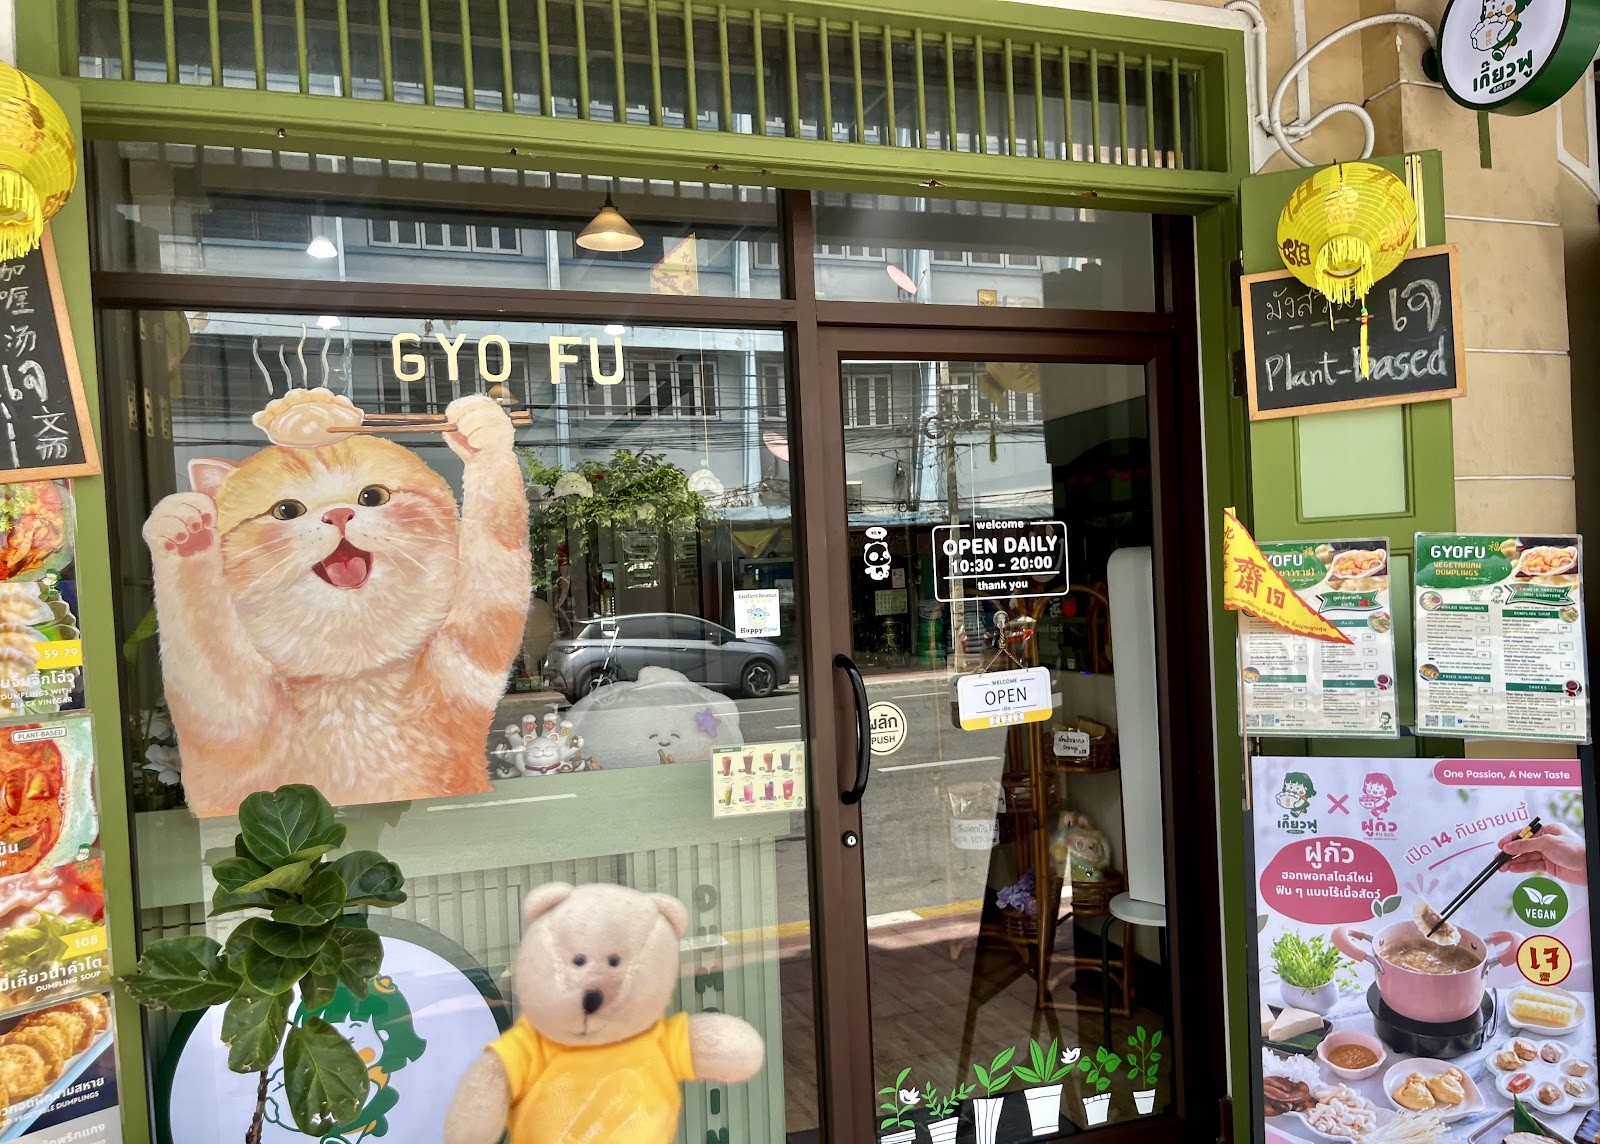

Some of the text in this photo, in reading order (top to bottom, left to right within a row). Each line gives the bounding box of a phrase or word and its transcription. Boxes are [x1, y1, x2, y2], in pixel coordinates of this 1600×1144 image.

[1473, 49, 1533, 92] เกี๊ยวฟู
[1389, 278, 1441, 332] เจ
[391, 333, 626, 384] GYO FU
[976, 519, 1024, 530] welcome
[943, 535, 1058, 556] OPEN DAILY
[1430, 545, 1486, 559] GYOFU
[951, 558, 994, 574] 10:30
[1010, 556, 1053, 571] 20:00
[1433, 561, 1481, 569] VEGETARIAN
[977, 580, 1028, 592] thank you
[44, 647, 79, 660] 59-79
[991, 677, 1018, 686] WELCOME
[1, 687, 72, 700] DUMPLINGS WITH
[985, 686, 1028, 706] OPEN
[11, 695, 74, 709] BLACK VINEGAR
[17, 730, 64, 741] PLANT-BASED
[872, 735, 896, 745] PUSH
[1443, 769, 1571, 781] One Passion, A New Taste
[1277, 814, 1318, 834] เกี๊ยวฟู
[1405, 801, 1530, 865] เปิด 14 กันยายนนี้
[1305, 841, 1355, 869] ฝูกัว
[1281, 871, 1374, 884] ฮอทพอทสไตล์ใหม่
[1524, 907, 1557, 920] VEGAN
[74, 935, 99, 949] 108
[35, 969, 102, 993] DUMPLING SOUP
[55, 1089, 101, 1111] DUMPLINGS
